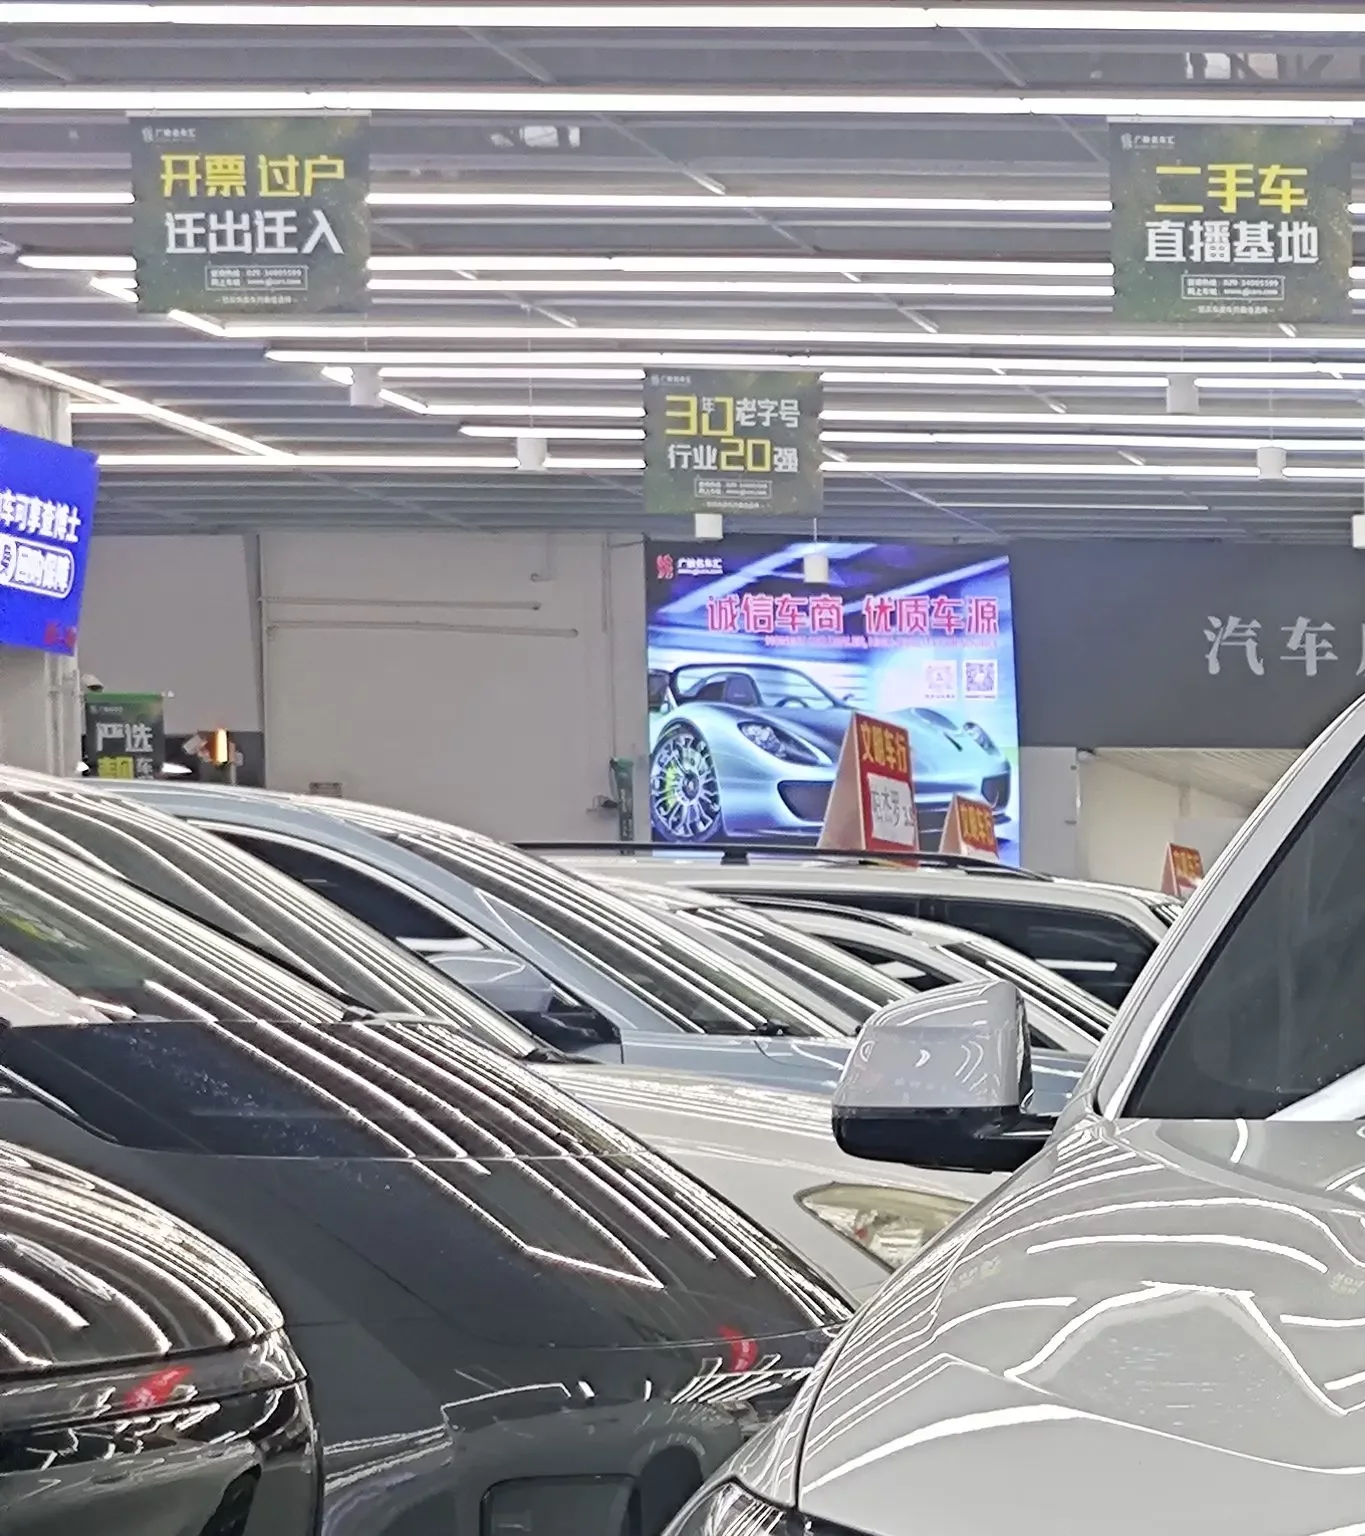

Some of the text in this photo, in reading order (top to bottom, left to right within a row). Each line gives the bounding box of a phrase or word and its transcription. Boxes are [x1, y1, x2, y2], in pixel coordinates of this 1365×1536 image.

[160, 153, 345, 198] 开票 过户
[1154, 163, 1309, 214] 二手车
[164, 208, 345, 255] 迁出迁入
[1144, 219, 1320, 264] 直播基地
[667, 437, 799, 473] 行业20强
[705, 592, 999, 636] 诚信车商 优质车源
[95, 722, 154, 753] 严选
